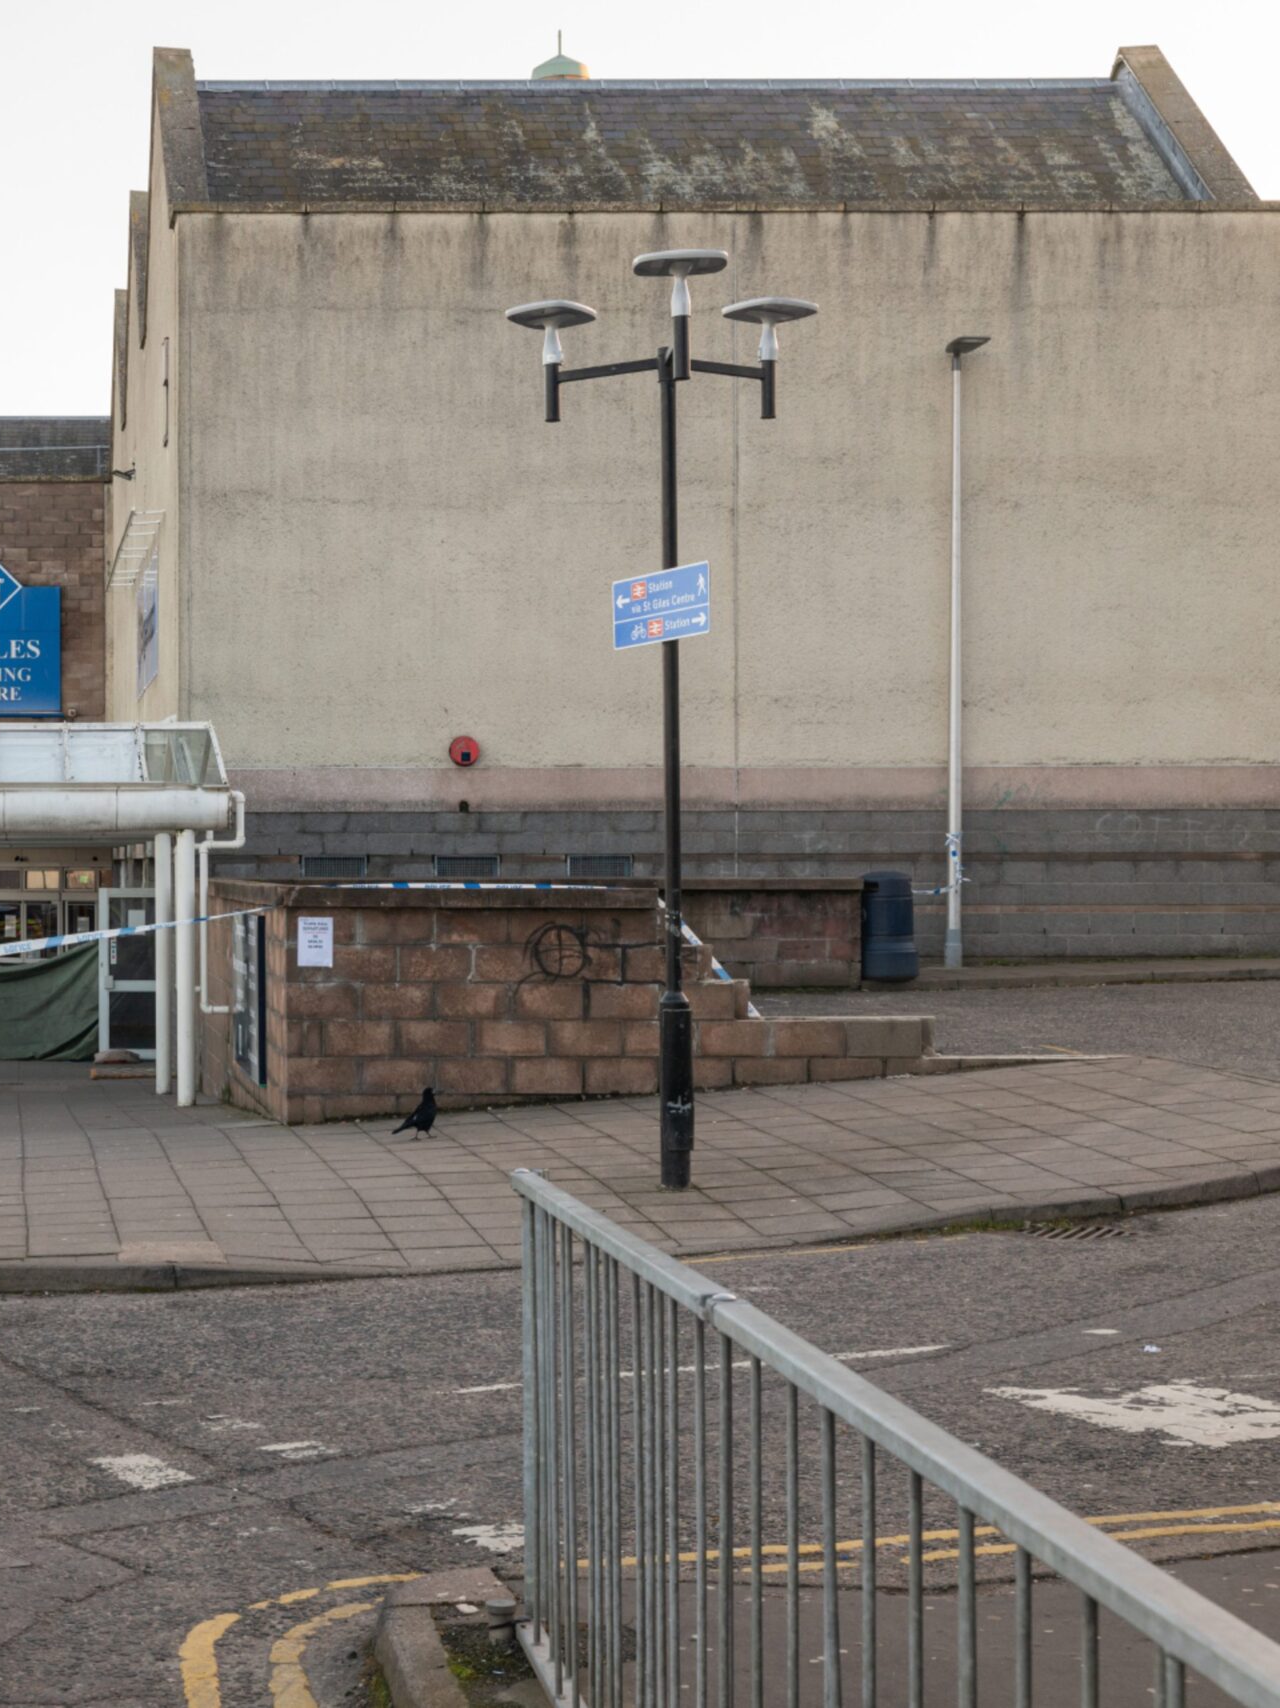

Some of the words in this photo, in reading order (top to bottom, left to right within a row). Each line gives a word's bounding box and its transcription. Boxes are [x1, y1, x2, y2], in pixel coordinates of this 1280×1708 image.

[648, 580, 673, 593] Station
[652, 598, 670, 610] Giles
[671, 594, 696, 605] Centre
[664, 618, 690, 631] Station
